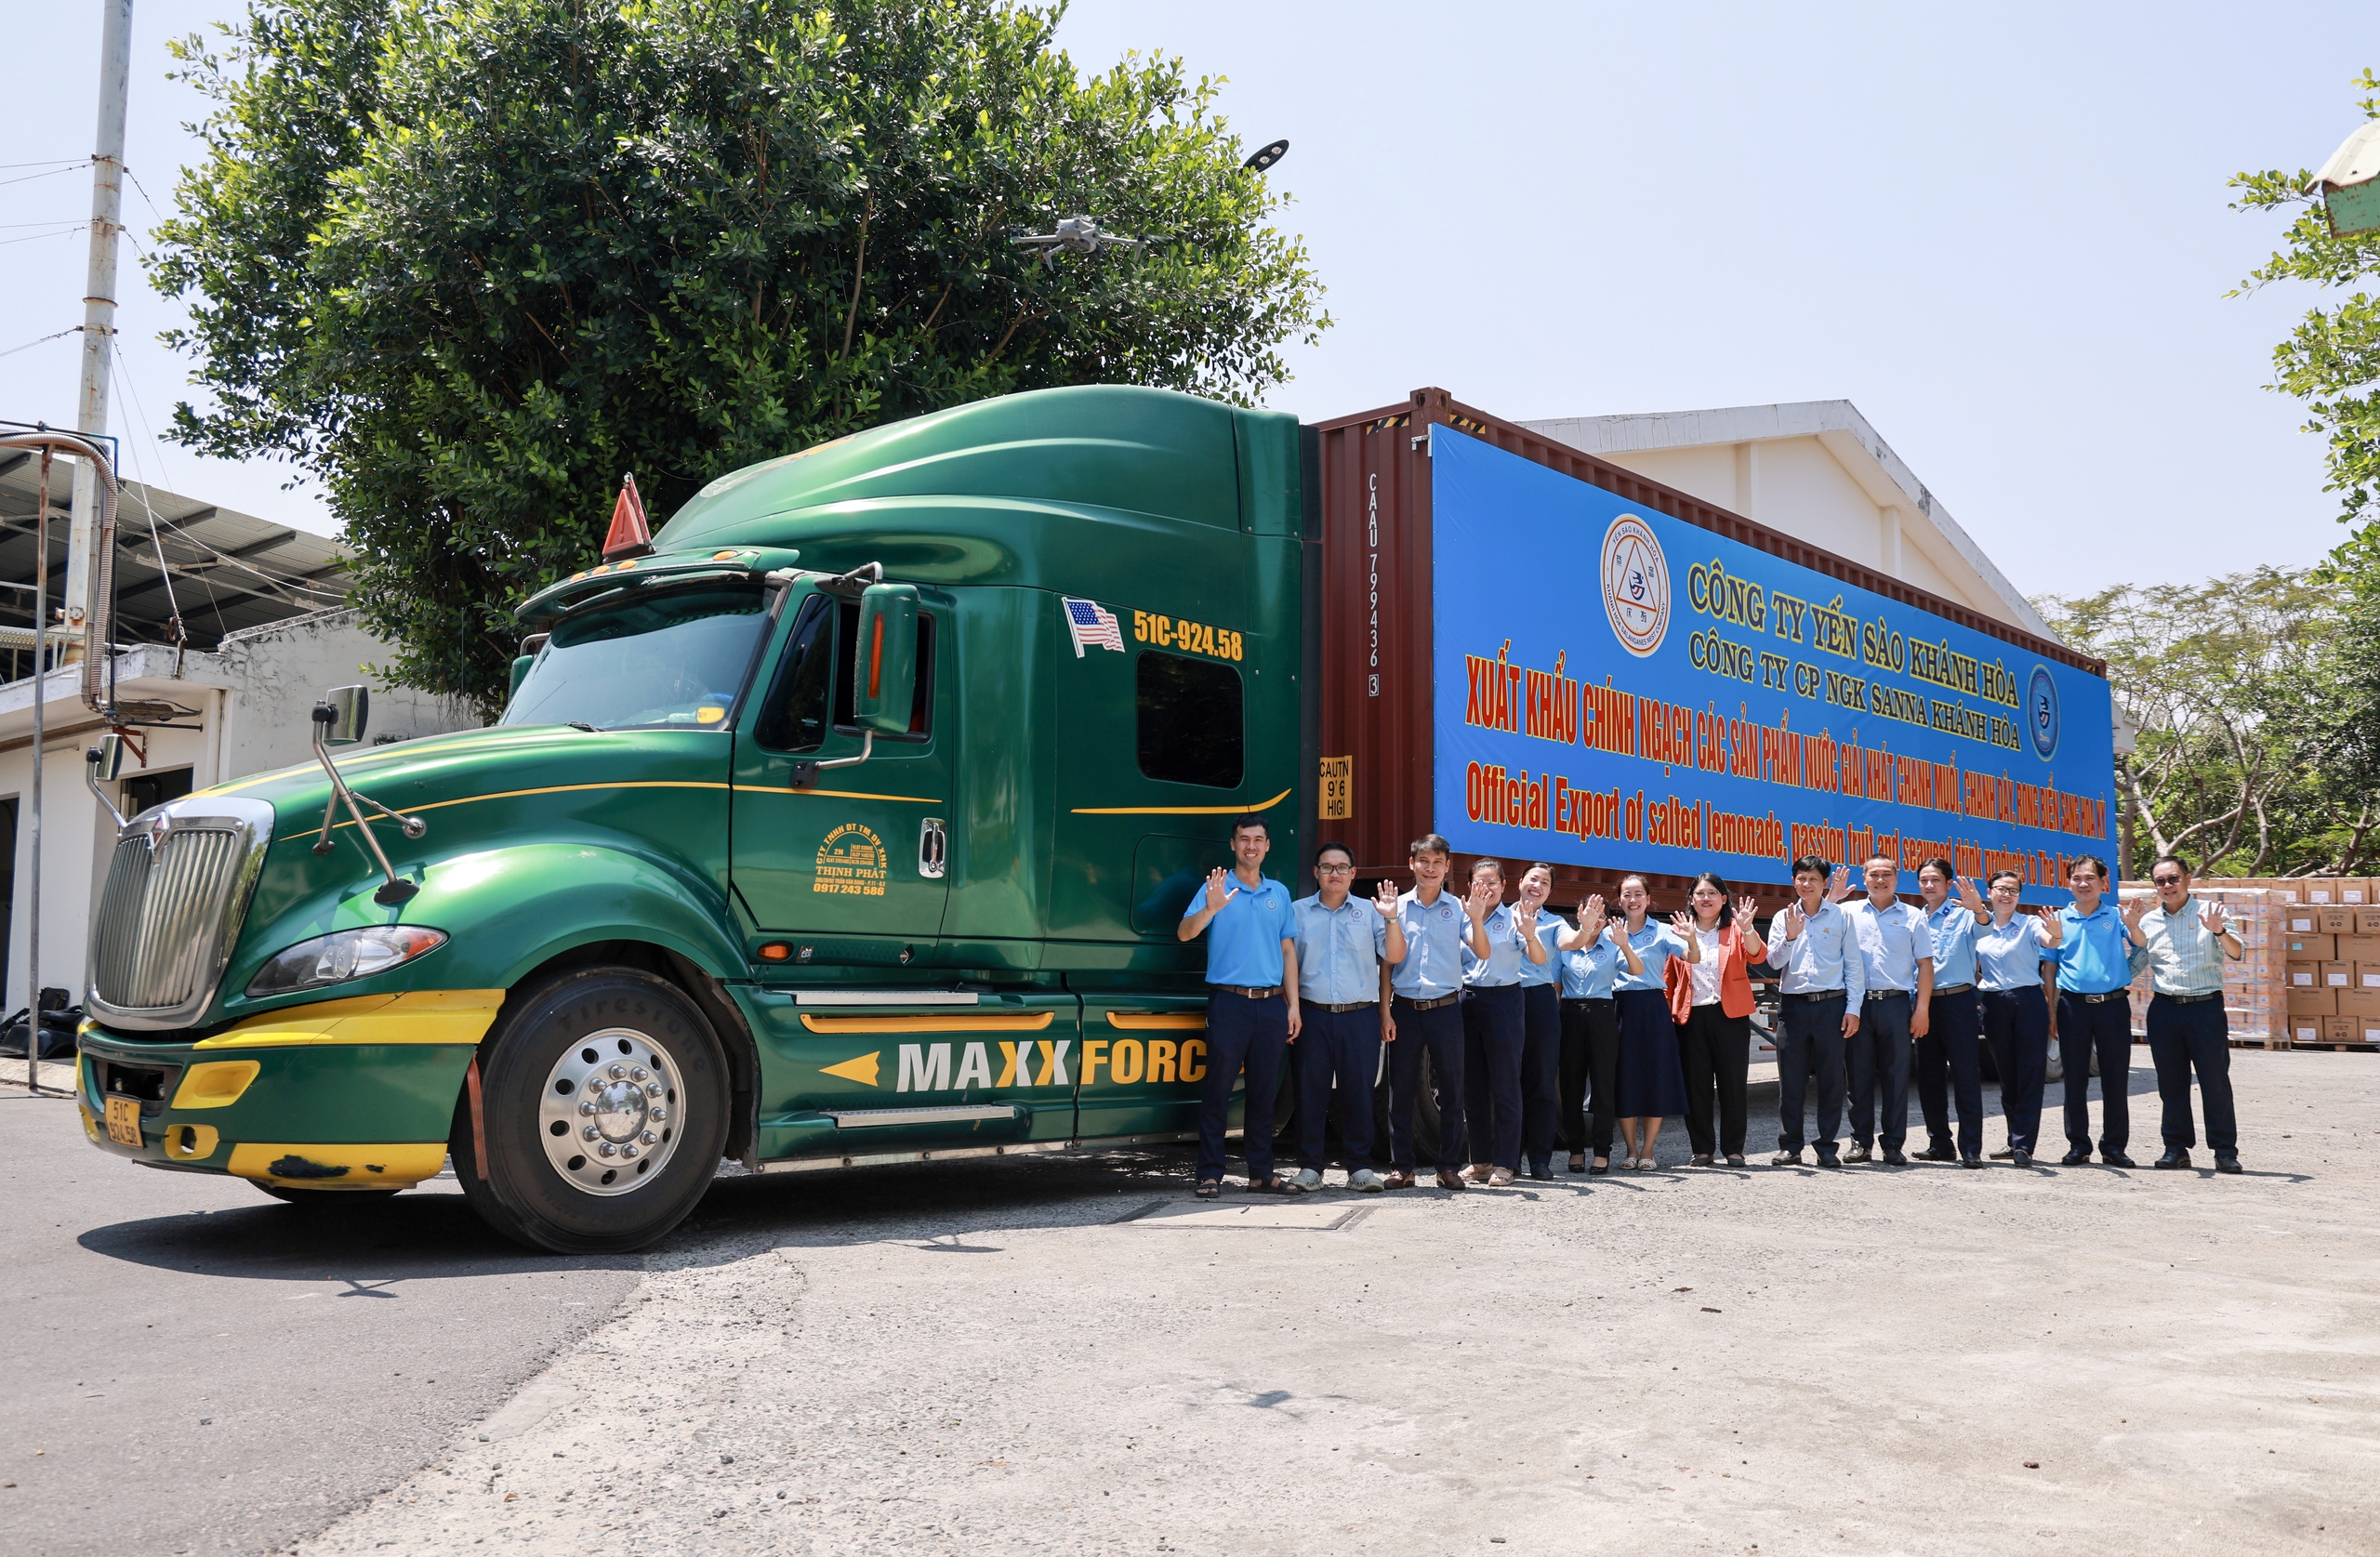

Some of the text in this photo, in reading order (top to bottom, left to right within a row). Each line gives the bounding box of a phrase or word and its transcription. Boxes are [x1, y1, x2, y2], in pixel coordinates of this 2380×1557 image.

[1368, 472, 1379, 694] CAAU 799436 3
[1134, 610, 1243, 662] 51C-924.58
[1687, 557, 2020, 709] CÔNG TY YẾN SÀO KHÁNH HÒA
[1688, 626, 1755, 685] CÔNG
[1759, 651, 1790, 693] TY
[1793, 661, 1822, 700] CP
[1825, 669, 1868, 713] NGK
[1871, 682, 1929, 728] SANNA
[1931, 699, 1988, 744] KHÁNH
[1990, 712, 2022, 752] HÒA
[1464, 638, 1522, 734] XUẤT
[1525, 649, 1579, 746] KHẨU
[1582, 674, 1635, 758] CHÍNH
[1638, 695, 1694, 778] NGẠCH
[1696, 700, 1726, 775] CÁC
[1729, 701, 1760, 781] SẢN
[1762, 707, 1802, 788] PHẨM
[1804, 728, 1839, 795] NƯỚC
[1840, 727, 1864, 799] GIẢI
[1865, 741, 1895, 804] KHÁT
[1896, 754, 1933, 810] CHANH
[1934, 750, 1964, 822] MUỐI,
[1964, 769, 1997, 822] CHANH
[2016, 782, 2040, 829] RONG
[2040, 772, 2061, 833] BIỂN
[2061, 791, 2081, 837] SANG
[2081, 796, 2097, 839] HOA
[815, 845, 826, 864] CTY
[824, 825, 844, 845] TNHH
[846, 823, 857, 831] ĐT
[858, 824, 872, 836] TM
[871, 834, 882, 846] DV
[878, 847, 887, 869] XNK
[1466, 759, 1549, 831] Official
[1554, 775, 1620, 843] Export
[1625, 789, 1644, 844] of
[1647, 794, 1702, 851] salted
[1706, 800, 1789, 865] lemonade,
[1791, 818, 1845, 866] passion
[1847, 821, 1875, 868] fruit
[1877, 828, 1900, 871] and
[1954, 837, 1983, 879] drink
[1984, 844, 2027, 886] products
[2027, 850, 2037, 887] to
[2037, 850, 2056, 888] The
[815, 865, 887, 879] THỊNH PHÁT
[833, 848, 844, 856] 2N
[813, 883, 885, 896] 0917 243 586
[557, 996, 706, 1075] Firestone
[895, 1037, 1208, 1093] MAXXFORC
[113, 1101, 128, 1122] 51C
